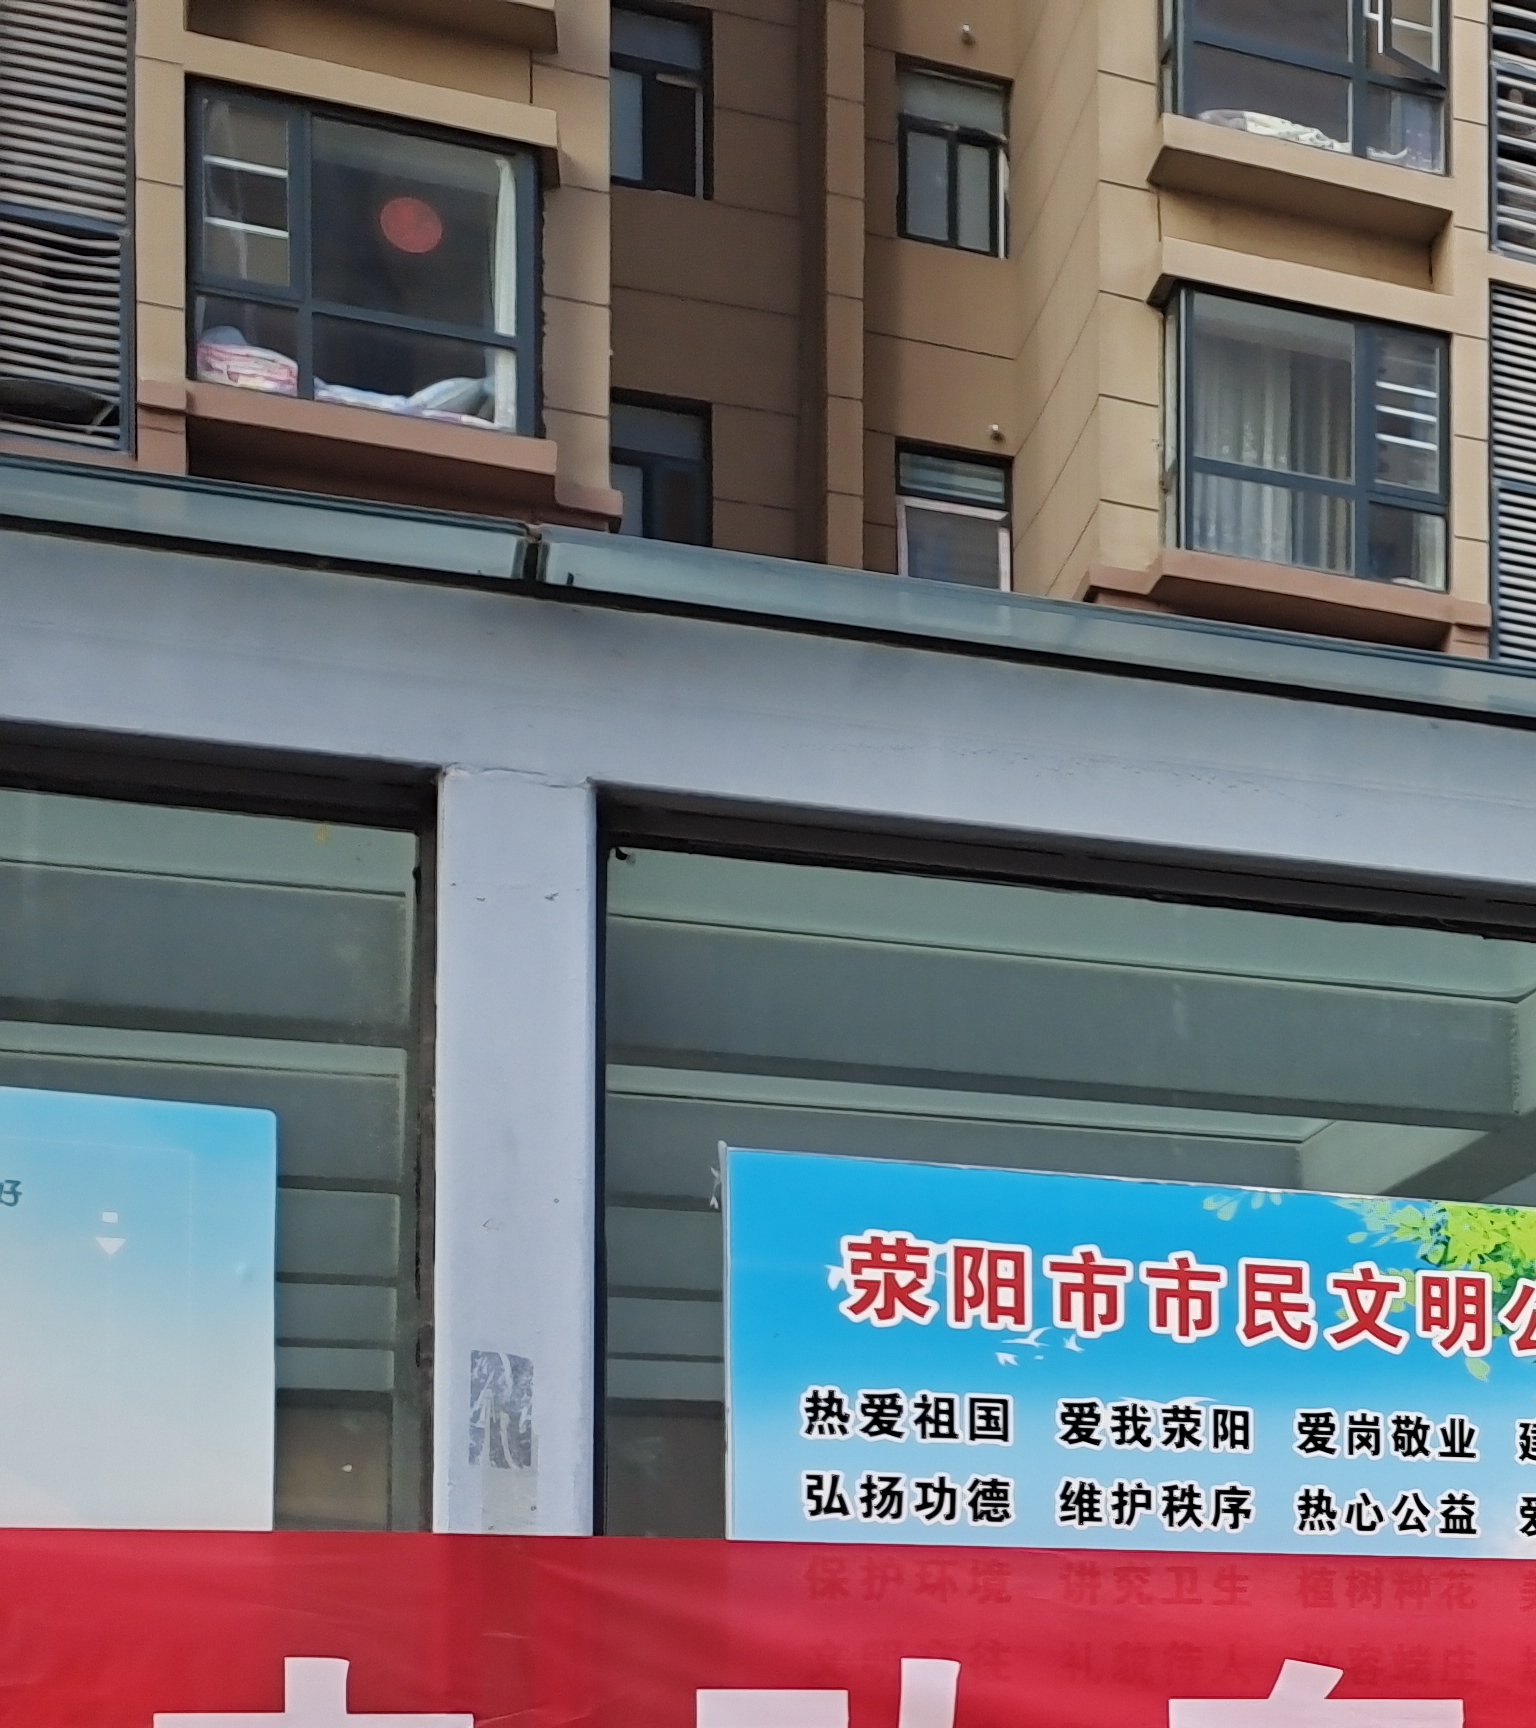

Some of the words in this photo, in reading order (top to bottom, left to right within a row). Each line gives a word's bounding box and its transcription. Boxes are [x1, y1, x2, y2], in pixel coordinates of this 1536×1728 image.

[802, 1388, 1012, 1446] 热爱祖国
[1057, 1400, 1253, 1452] 爱我荥阳
[1295, 1411, 1479, 1462] 爱岗敬业
[804, 1473, 1012, 1526] 弘扬功德
[1058, 1481, 1254, 1533] 维护秩序
[1295, 1488, 1479, 1538] 热心公益
